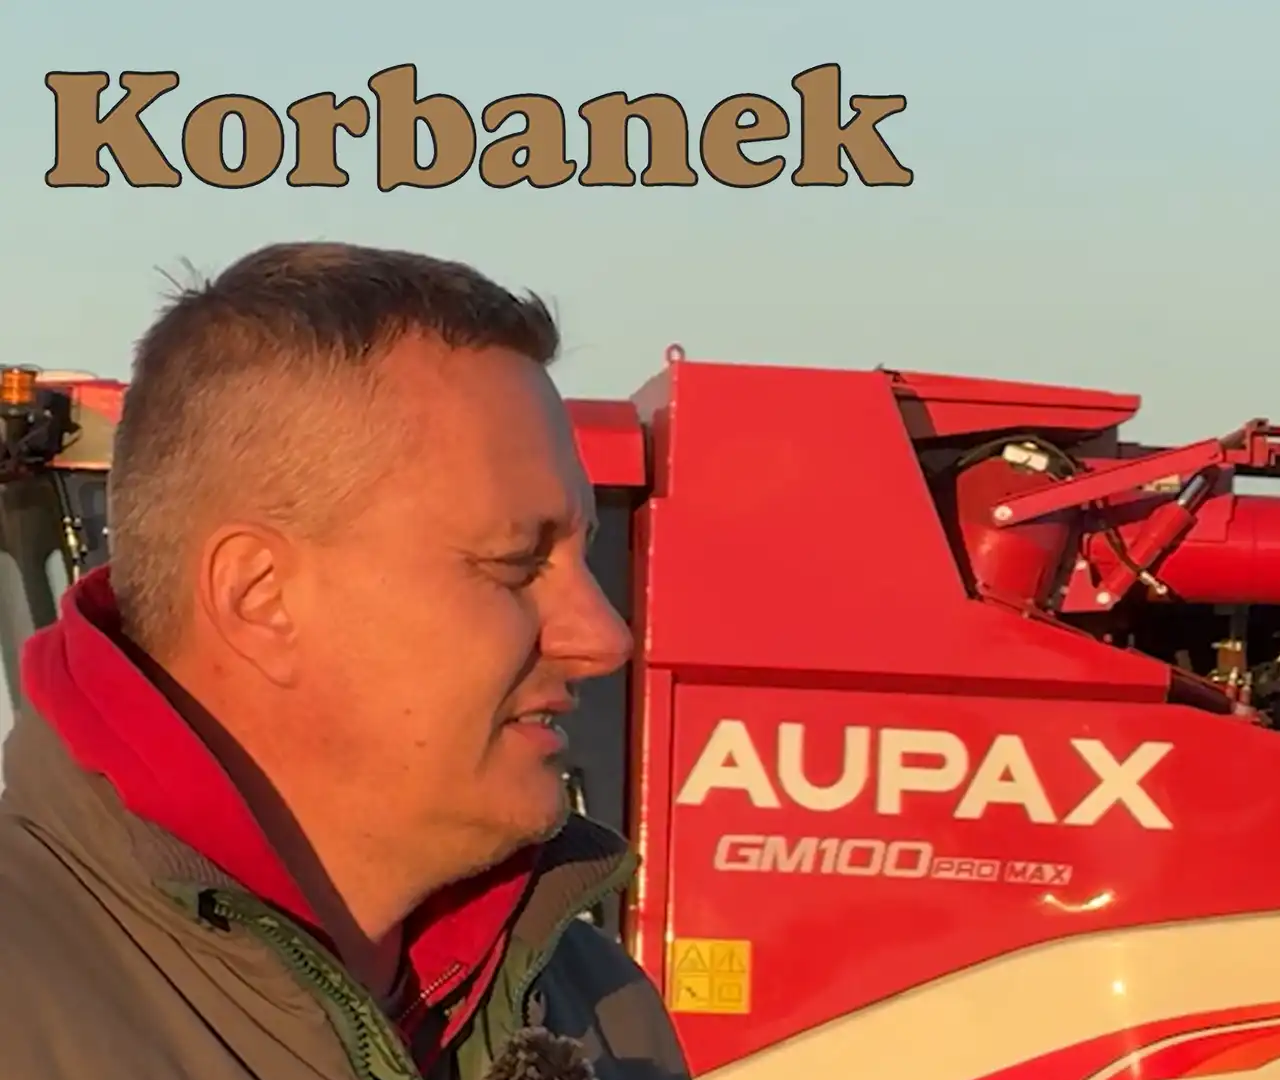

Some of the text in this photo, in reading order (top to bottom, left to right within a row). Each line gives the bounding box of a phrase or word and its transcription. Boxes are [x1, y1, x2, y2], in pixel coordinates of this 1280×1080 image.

[677, 720, 1174, 829] AUPAX
[714, 834, 1071, 885] GM100 PRO MAX
